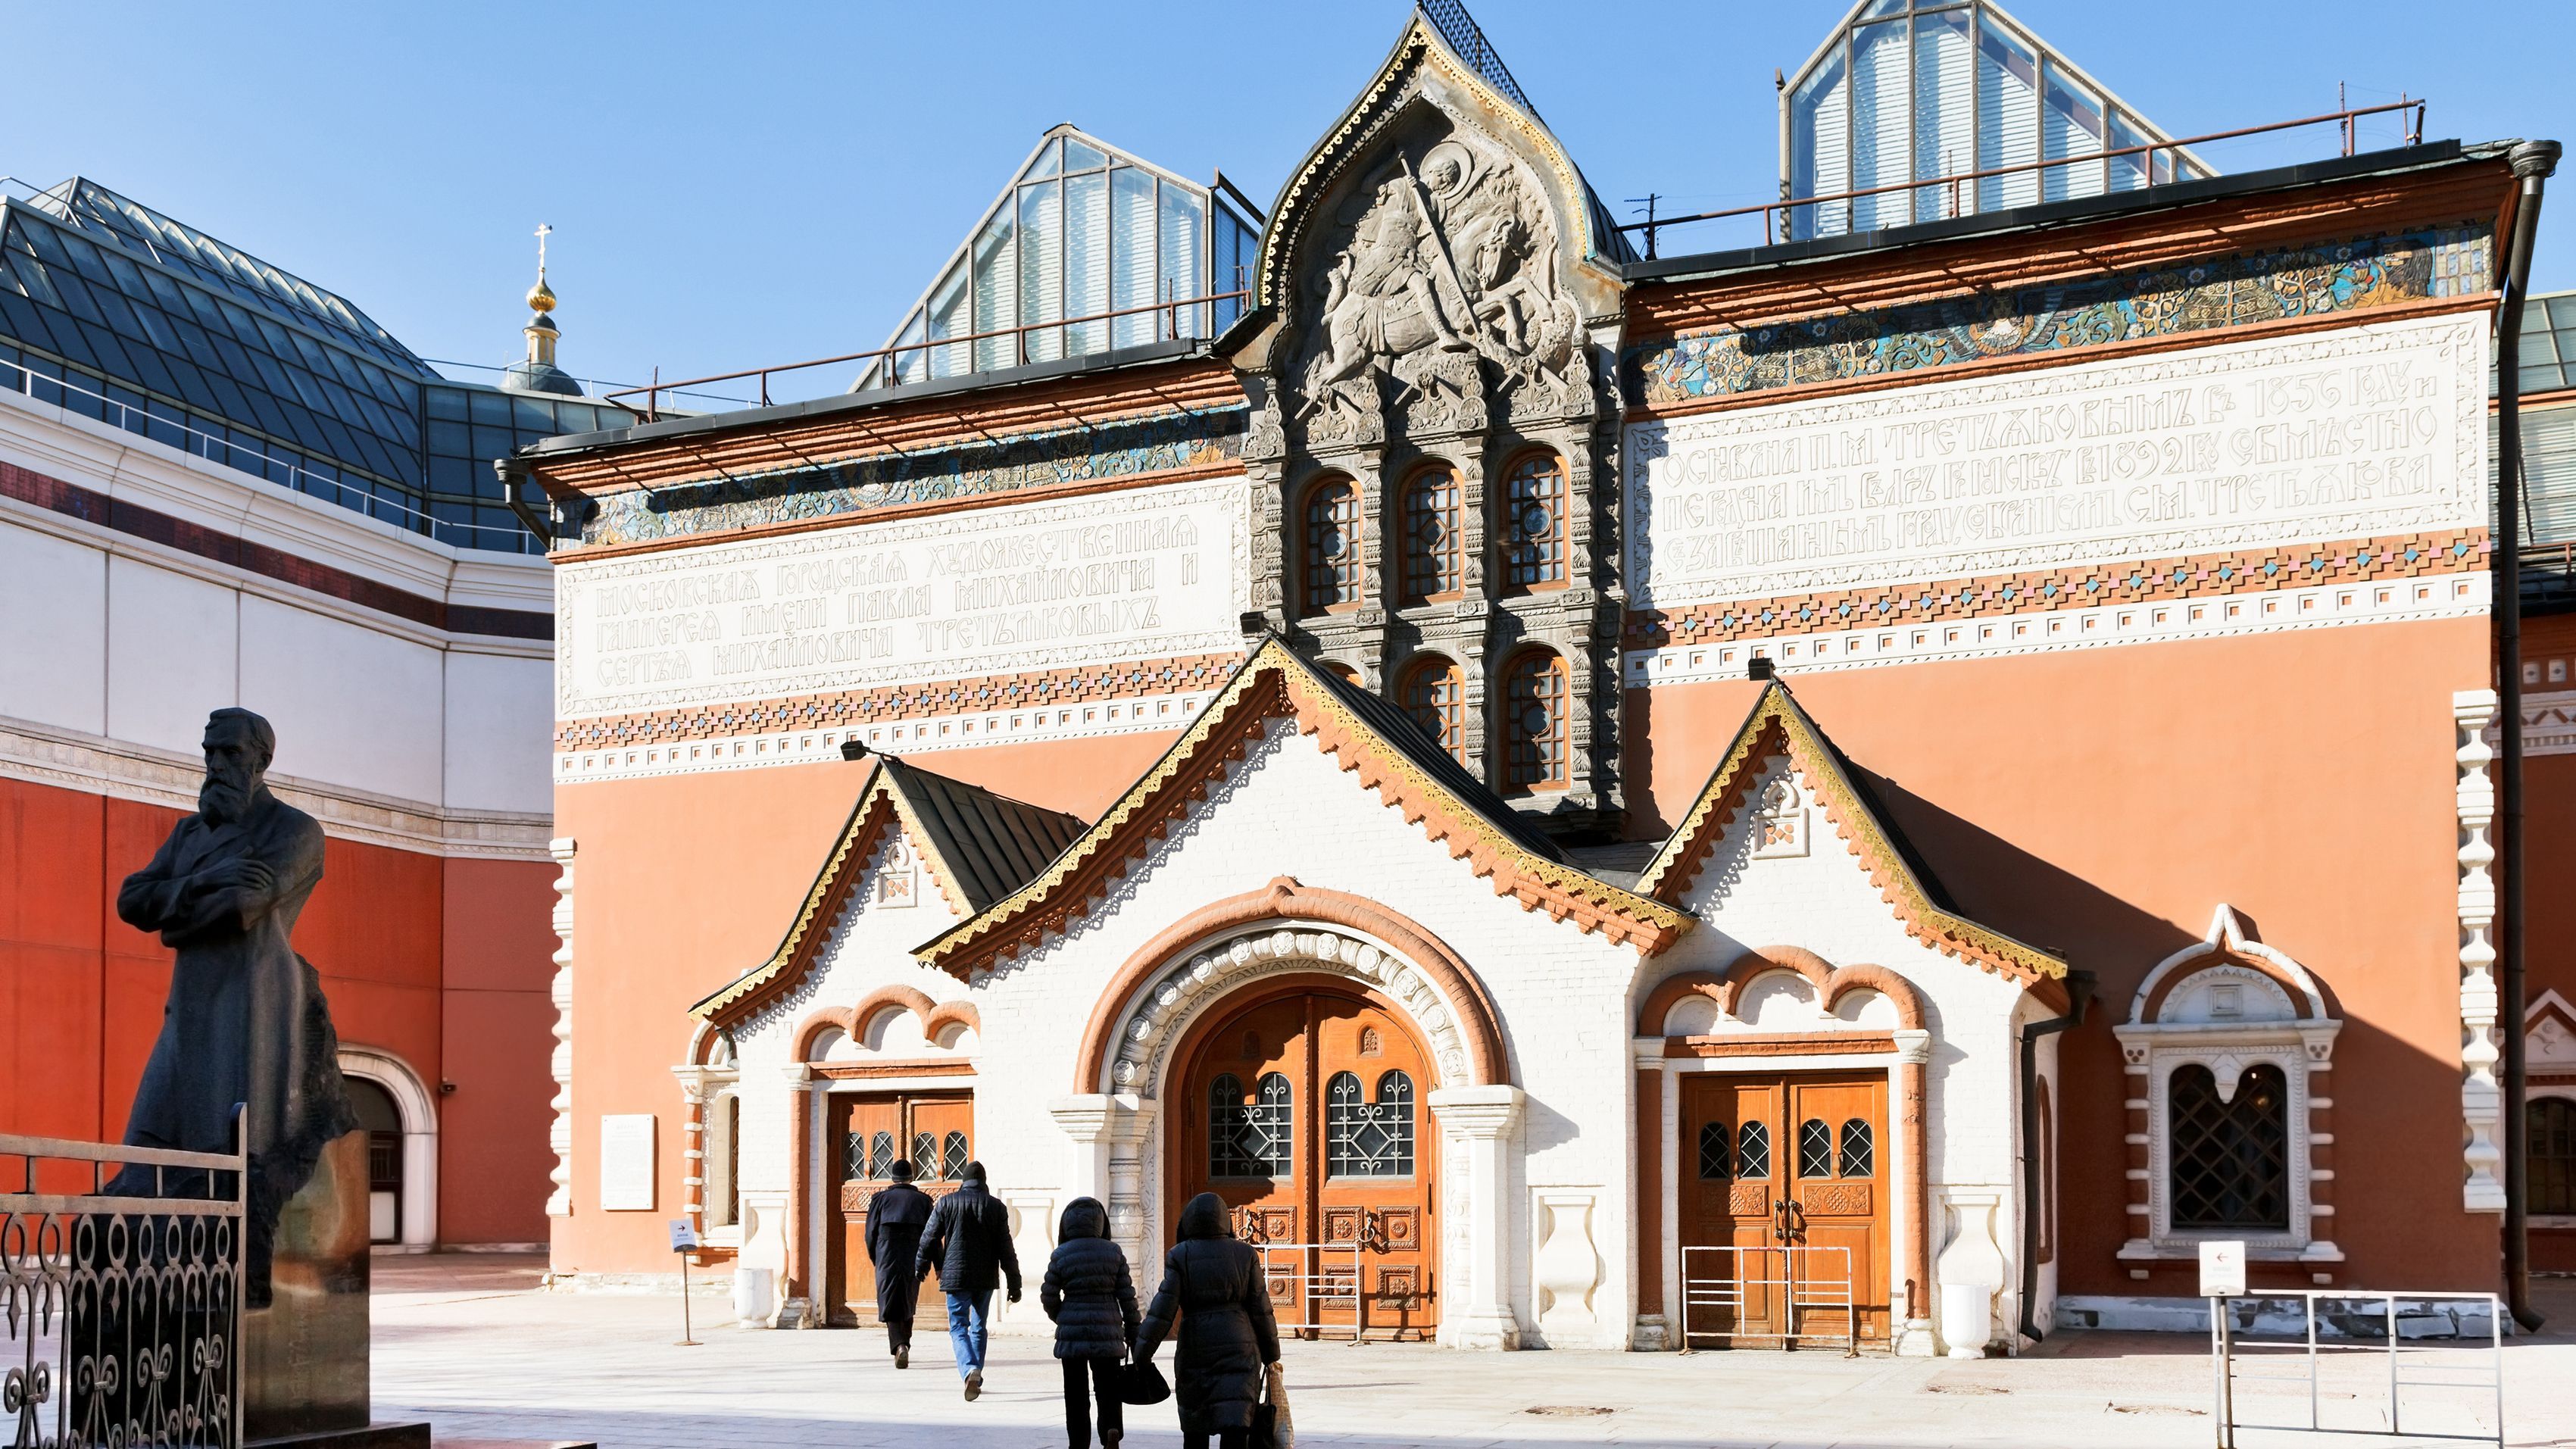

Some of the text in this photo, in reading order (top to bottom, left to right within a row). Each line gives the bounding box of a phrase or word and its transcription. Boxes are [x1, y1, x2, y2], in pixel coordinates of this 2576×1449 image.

[2247, 370, 2341, 417] 1856
[742, 597, 826, 636] ИМЕНИ
[848, 585, 931, 625] ПАВЛА
